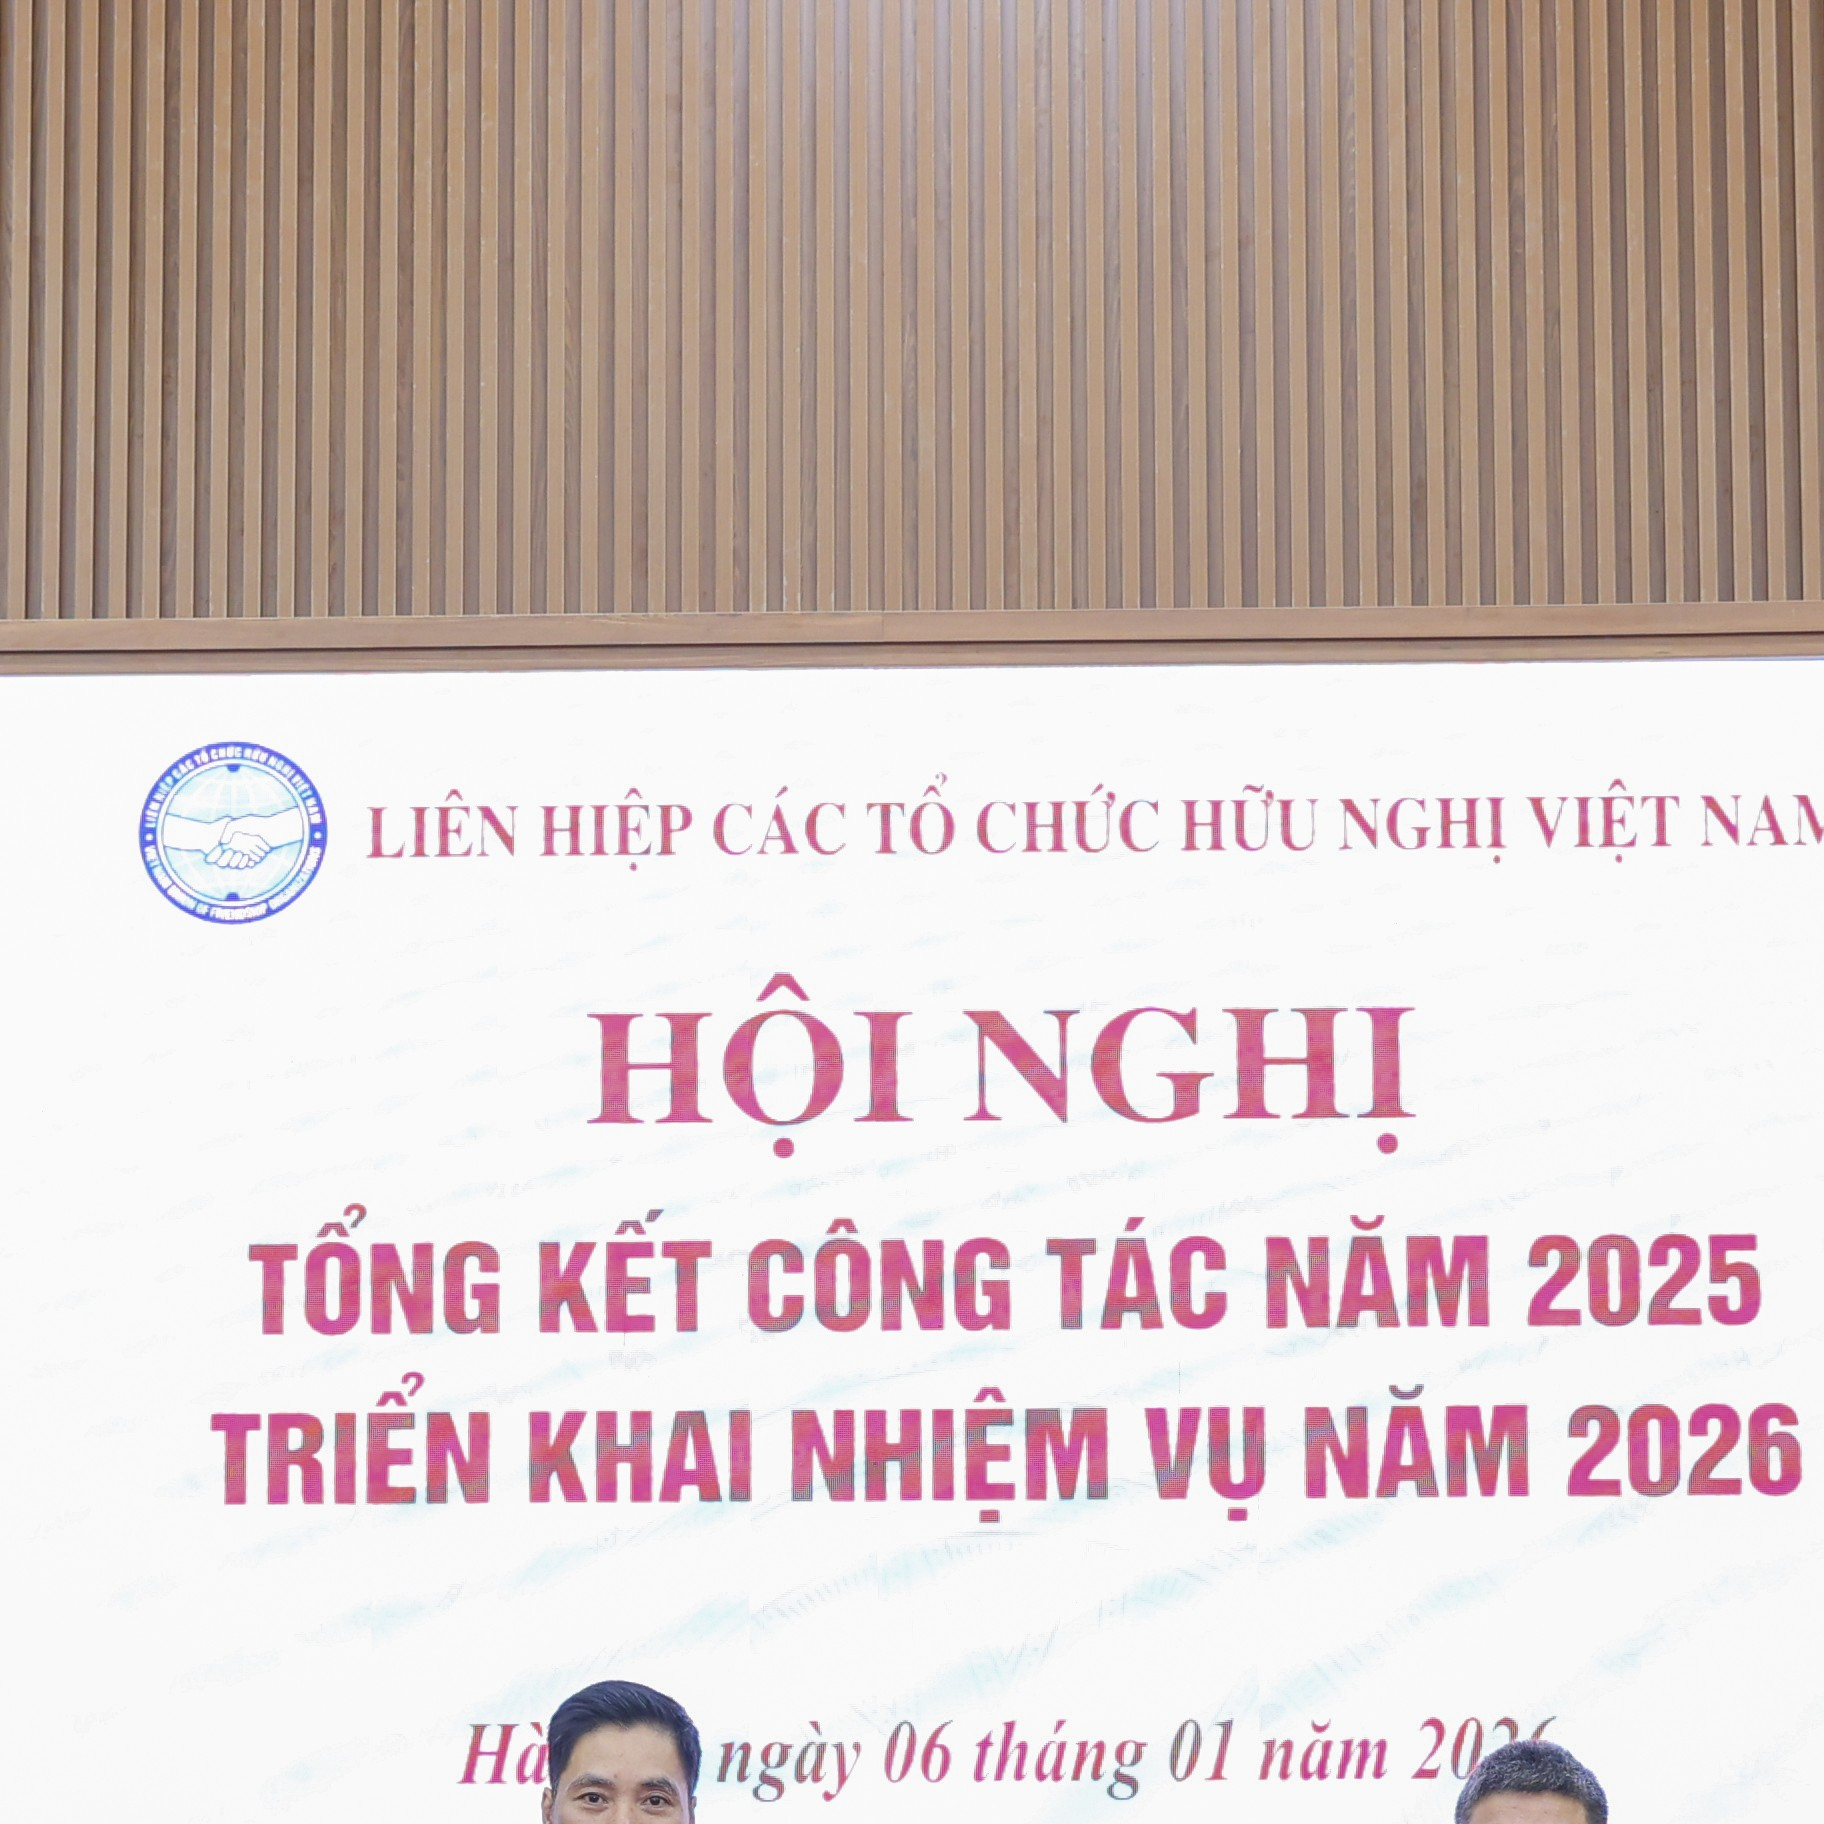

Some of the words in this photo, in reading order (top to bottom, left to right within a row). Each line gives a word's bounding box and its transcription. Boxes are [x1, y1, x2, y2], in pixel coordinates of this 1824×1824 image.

[368, 789, 516, 858] LIÊN
[542, 788, 692, 870] HIỆP
[714, 787, 844, 855] CÁC
[867, 774, 954, 854] TỔ
[977, 784, 1158, 853] CHỨC
[1183, 785, 1316, 851] HỮU
[1340, 797, 1504, 863] NGHỊ
[1530, 779, 1679, 862] VIỆT
[587, 974, 912, 1158] HỘI
[964, 1007, 1415, 1154] NGHỊ
[249, 1203, 500, 1335] TỔNG
[539, 1209, 712, 1333] KẾT
[748, 1218, 1010, 1332] CÔNG
[1047, 1217, 1227, 1329] TÁC
[1266, 1215, 1489, 1328] NĂM
[1528, 1234, 1760, 1326] 2025
[211, 1372, 490, 1504] TRIỂN
[529, 1410, 751, 1503] KHAI
[792, 1387, 1108, 1523] NHIỆM
[1145, 1407, 1265, 1521] VỤ
[1305, 1385, 1529, 1498] NĂM
[1568, 1403, 1802, 1497] 2026
[717, 1721, 860, 1802] ngày
[885, 1722, 950, 1782] 06
[974, 1719, 1146, 1800] tháng
[1171, 1720, 1232, 1781] 01
[1260, 1722, 1387, 1780] năm
[1411, 1715, 1557, 1780] 20
